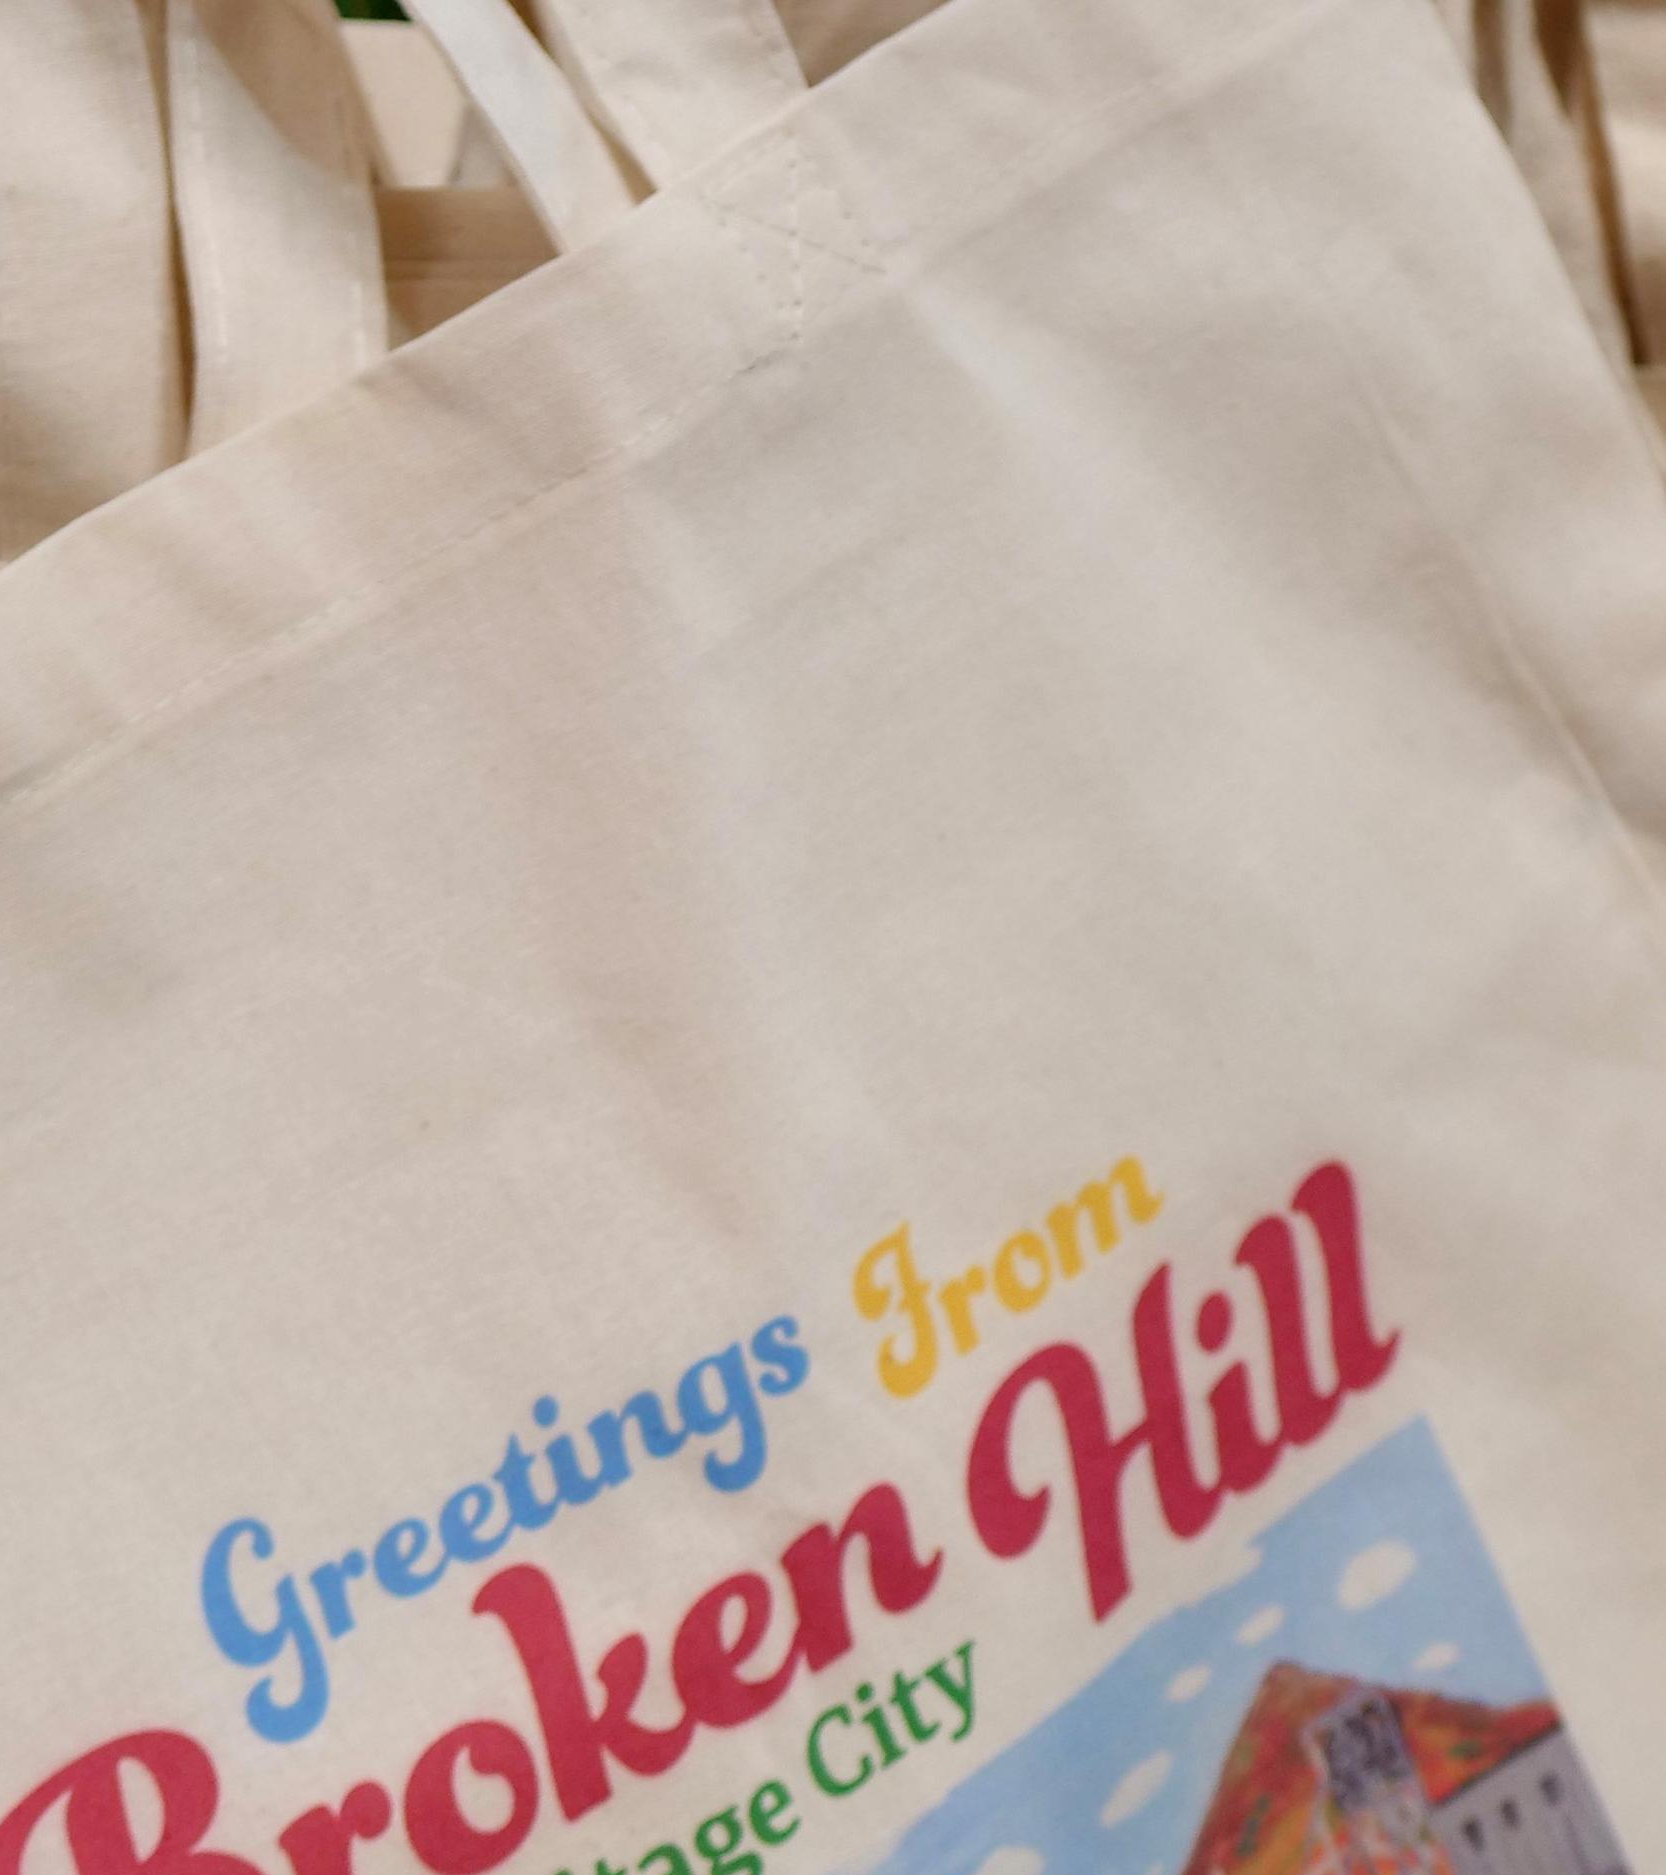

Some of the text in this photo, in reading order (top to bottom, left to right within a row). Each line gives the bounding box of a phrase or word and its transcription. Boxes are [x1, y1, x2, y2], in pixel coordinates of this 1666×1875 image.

[199, 1154, 1165, 1744] Greetings From
[965, 1159, 1400, 1624] Hill
[806, 1640, 979, 1798] City
